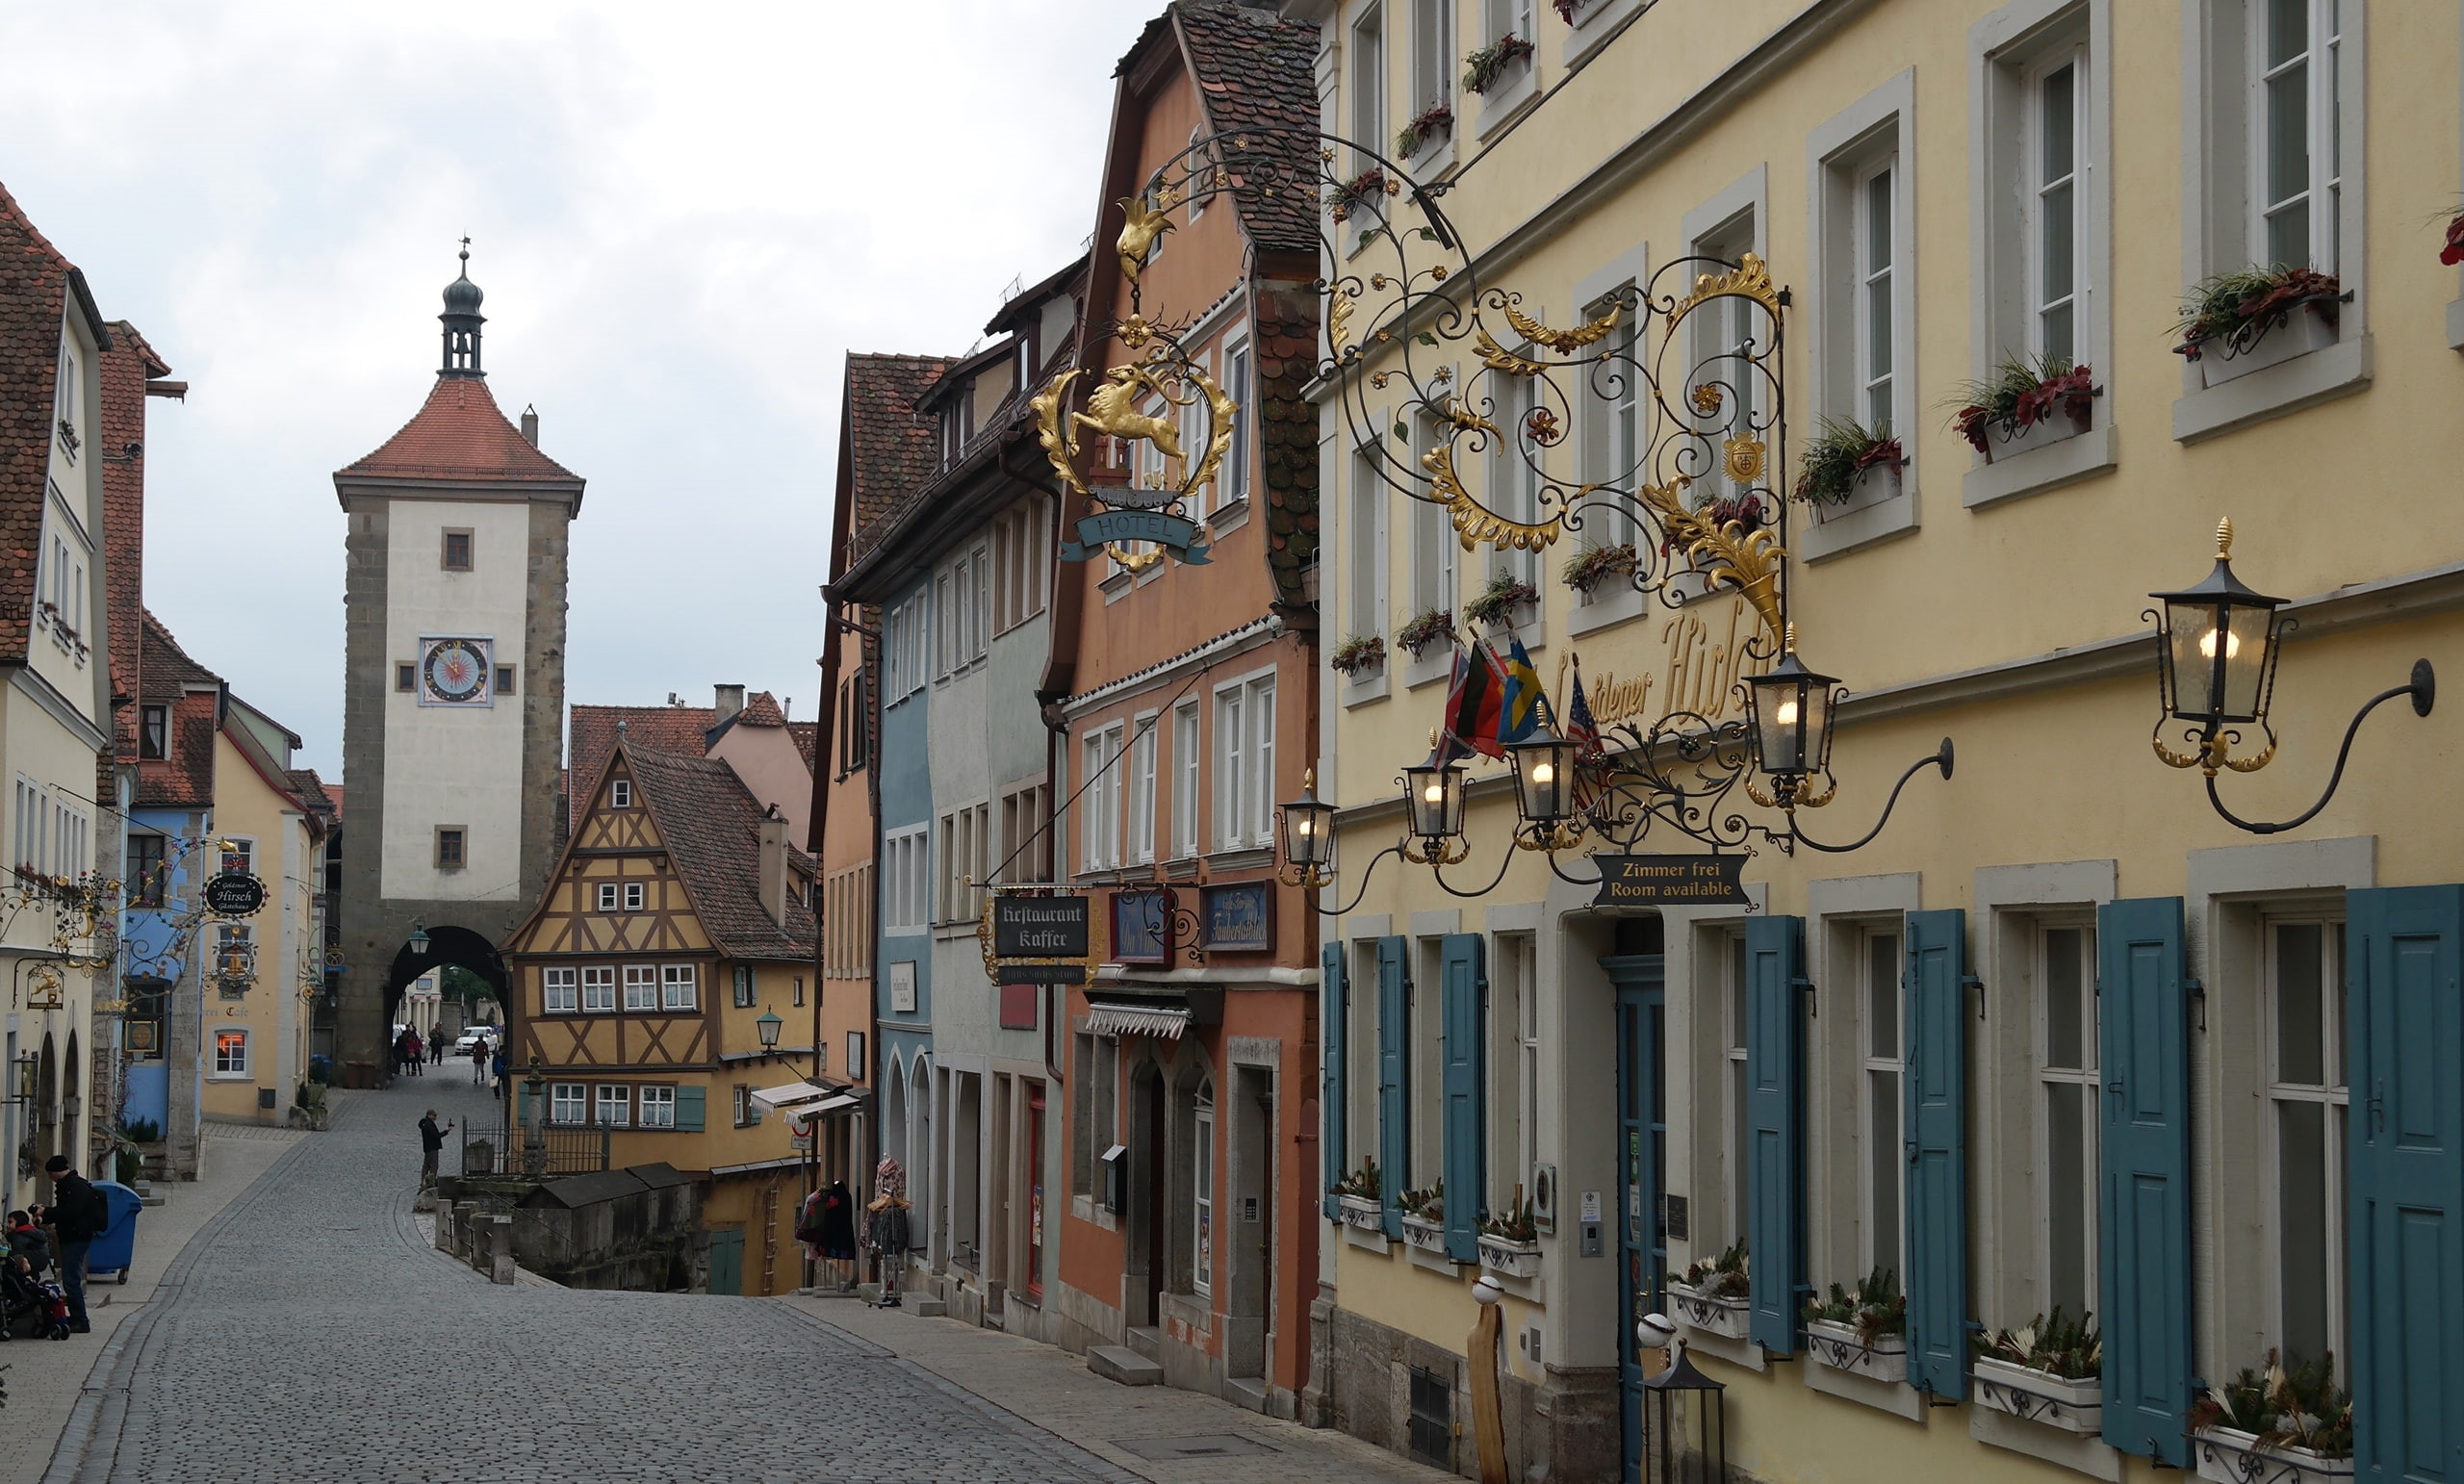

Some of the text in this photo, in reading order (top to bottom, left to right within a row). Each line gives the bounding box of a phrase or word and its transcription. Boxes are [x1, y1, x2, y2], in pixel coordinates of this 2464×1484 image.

[1097, 516, 1173, 538] HOTEL
[1623, 862, 1720, 877] Zimmer frei
[216, 889, 252, 902] Hirsch
[1611, 881, 1732, 896] Room available
[1003, 906, 1082, 924] Restaurant
